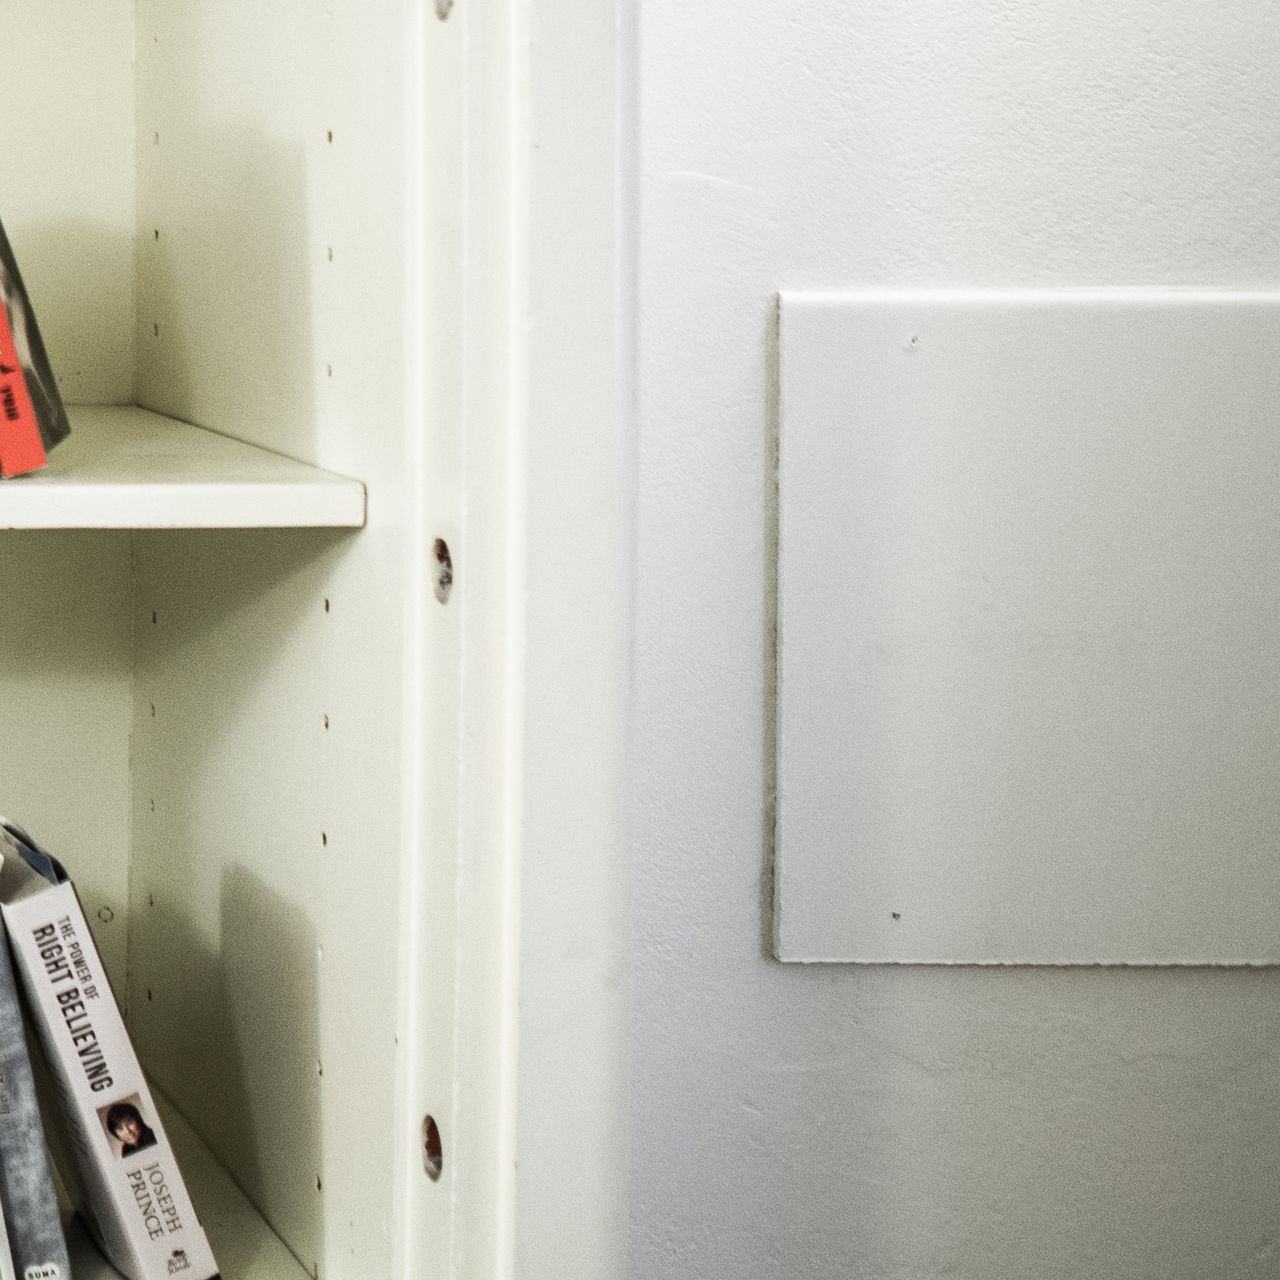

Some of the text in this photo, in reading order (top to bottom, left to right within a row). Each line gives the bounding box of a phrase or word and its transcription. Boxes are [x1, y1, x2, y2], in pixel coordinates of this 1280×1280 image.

[56, 914, 100, 1002] THE POWER OF
[31, 921, 116, 1096] RIGHT BELIEVING
[126, 1167, 165, 1243] PRINCE
[142, 1159, 184, 1236] JOSEPH
[27, 1269, 57, 1280] SUMA
